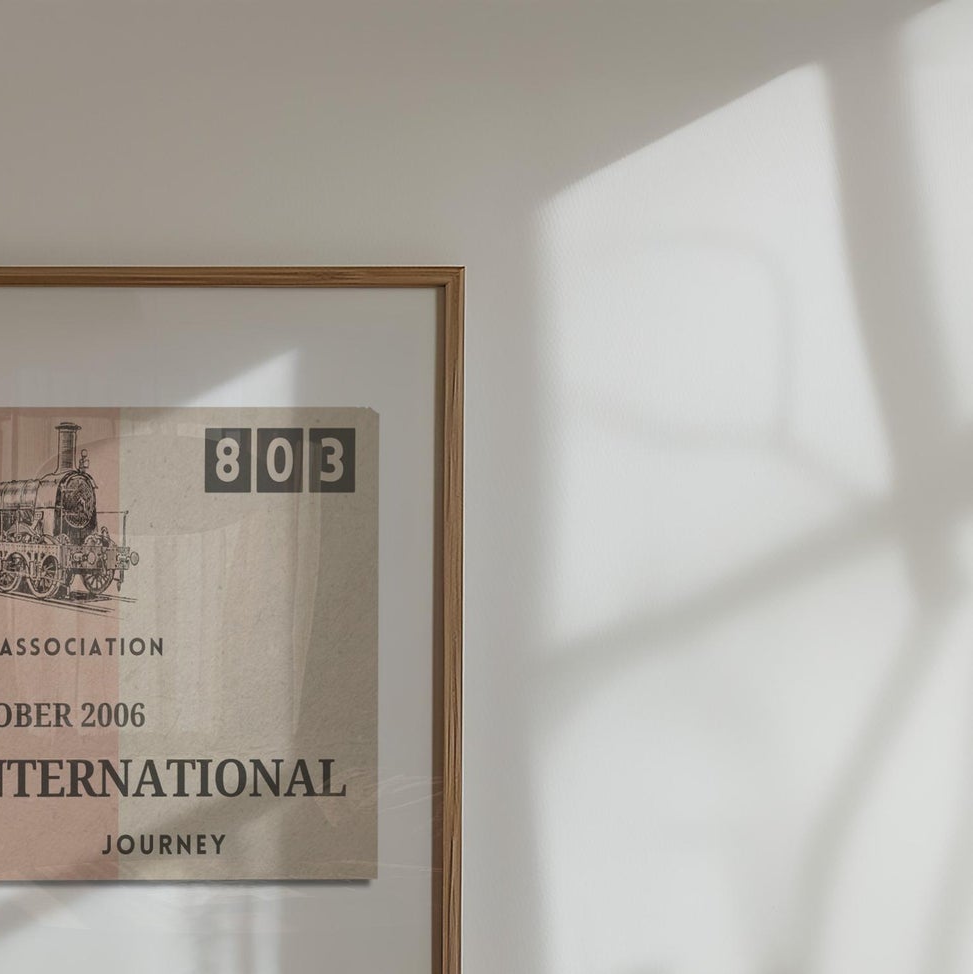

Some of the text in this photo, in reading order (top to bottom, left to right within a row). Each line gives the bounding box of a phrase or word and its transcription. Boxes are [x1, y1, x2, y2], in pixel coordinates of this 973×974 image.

[216, 437, 344, 483] 803
[81, 702, 146, 728] 2006
[101, 833, 226, 857] JOURNEY
